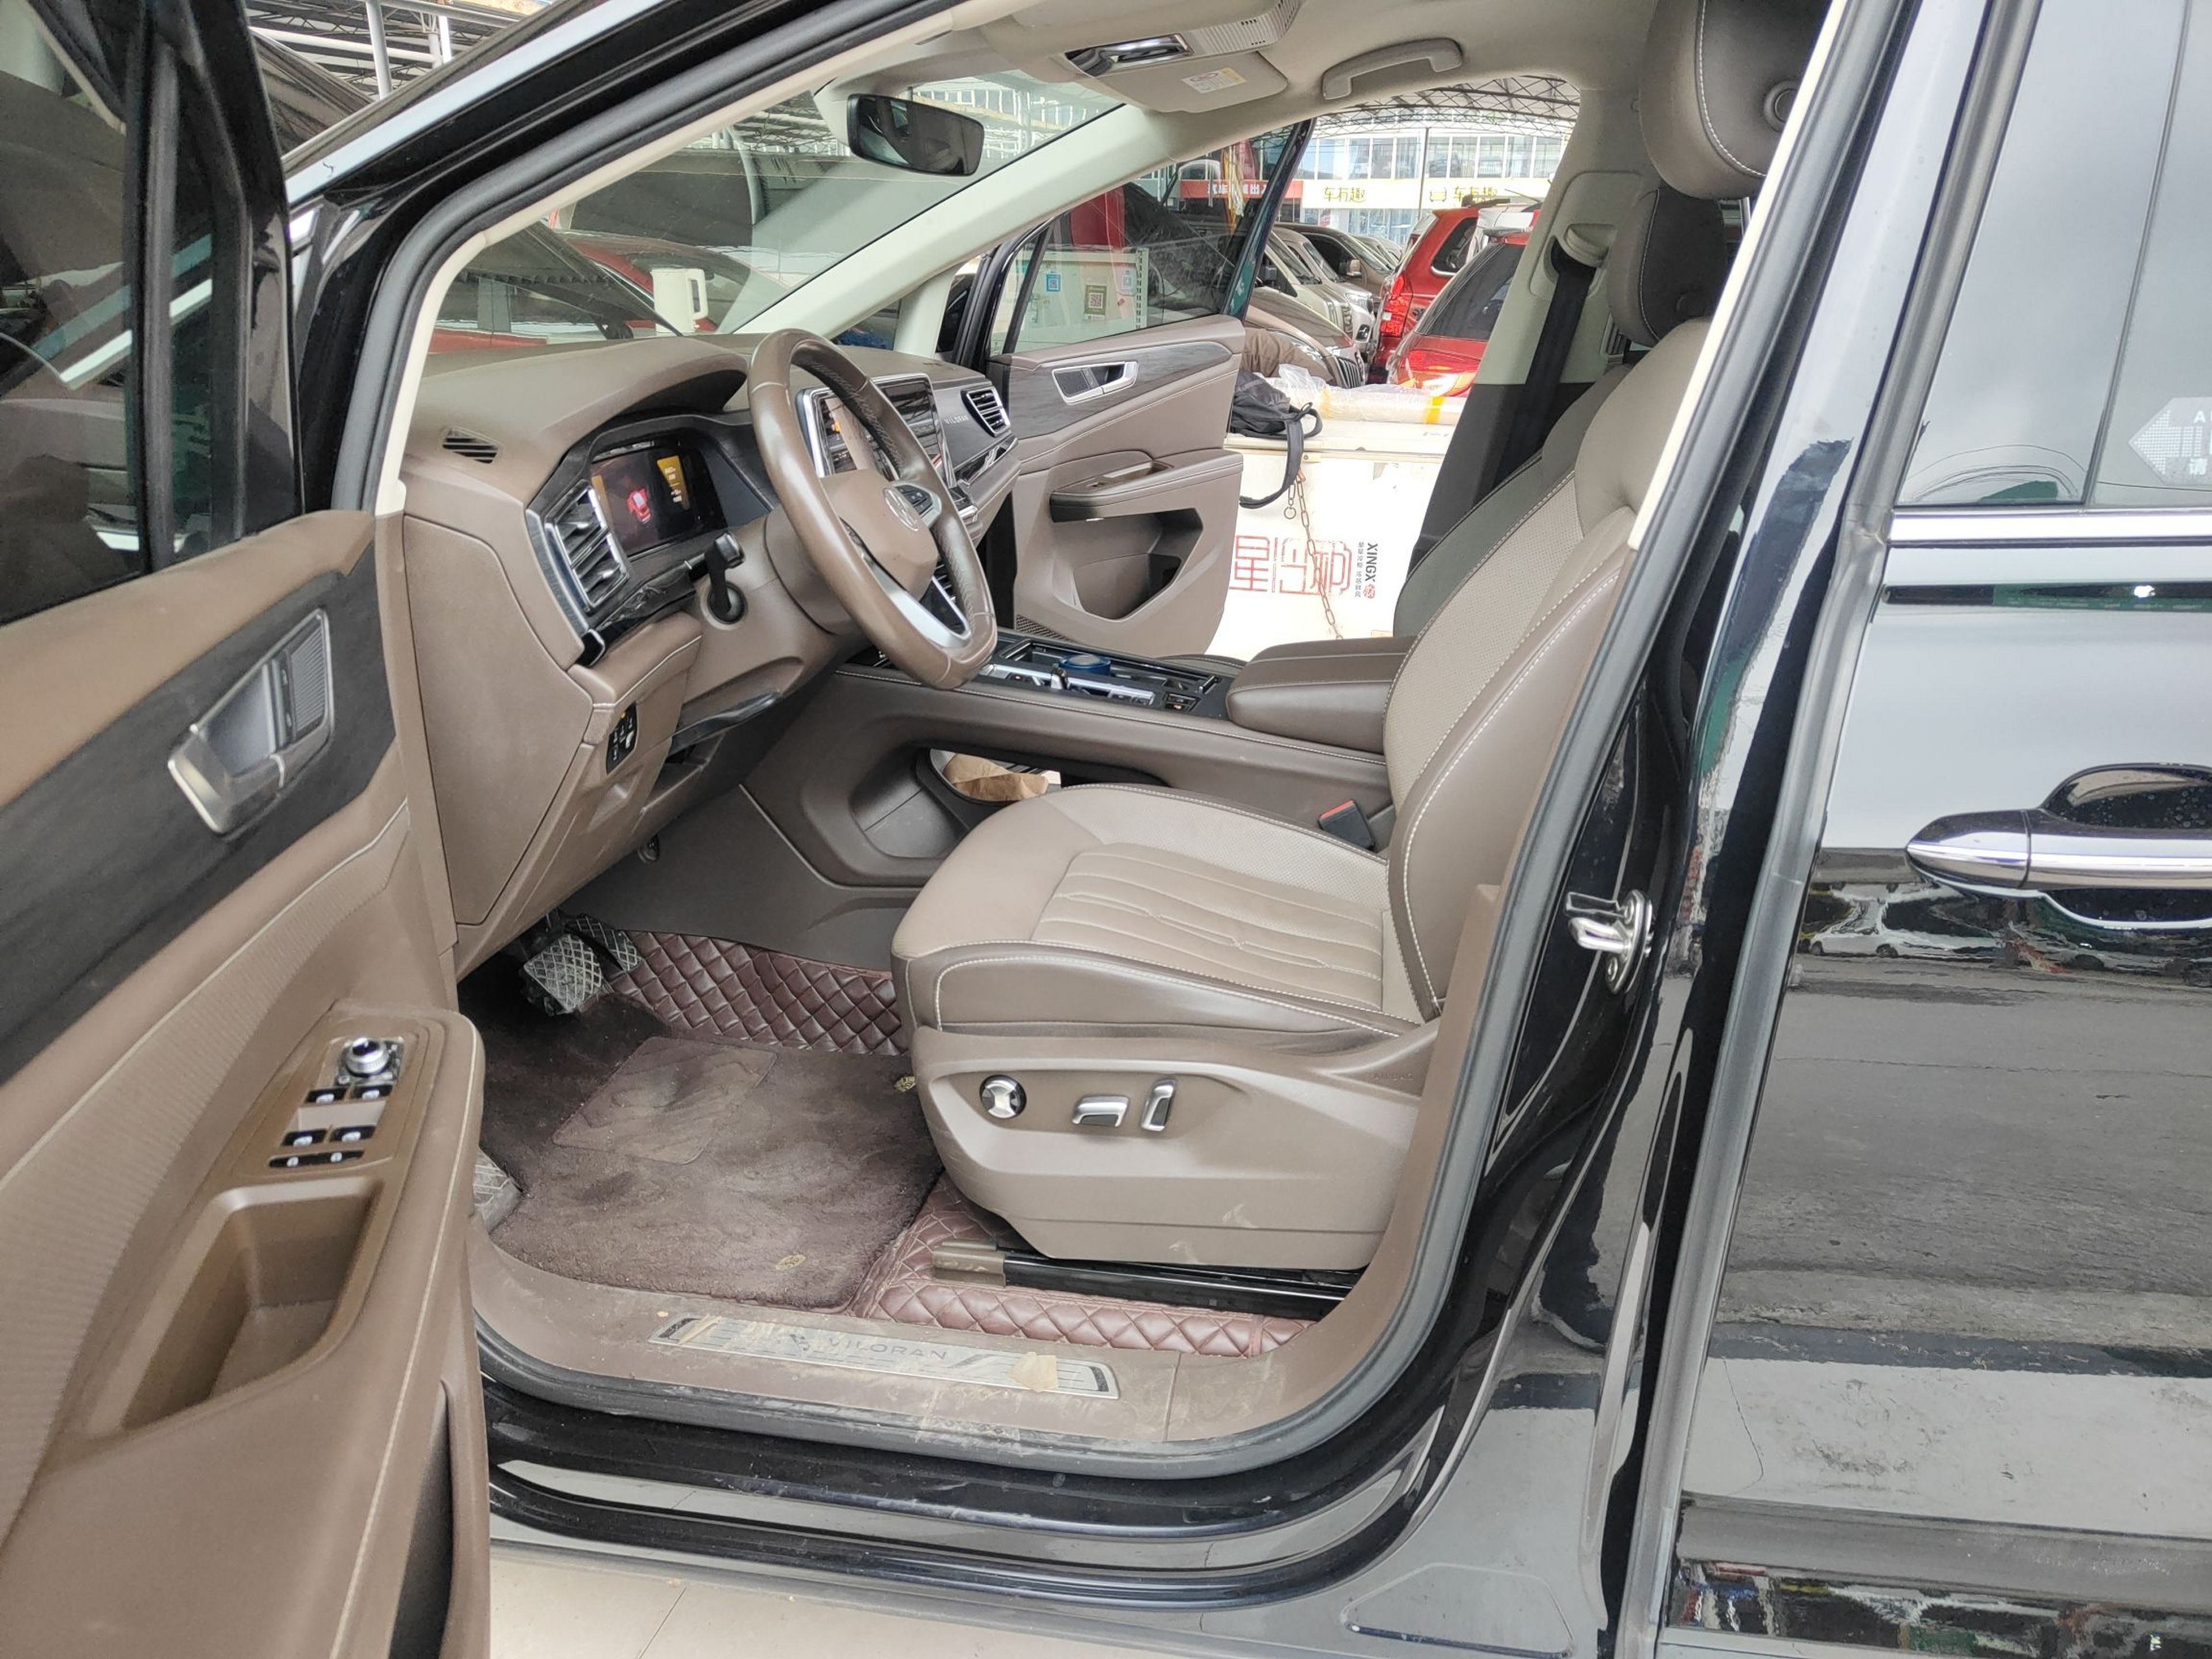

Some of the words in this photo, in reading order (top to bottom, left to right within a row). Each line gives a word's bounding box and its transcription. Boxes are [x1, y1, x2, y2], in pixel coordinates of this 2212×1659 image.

[1324, 187, 1366, 203] 车有趣
[1366, 542, 1378, 582] XINGX
[830, 1338, 947, 1359] VILORAN
